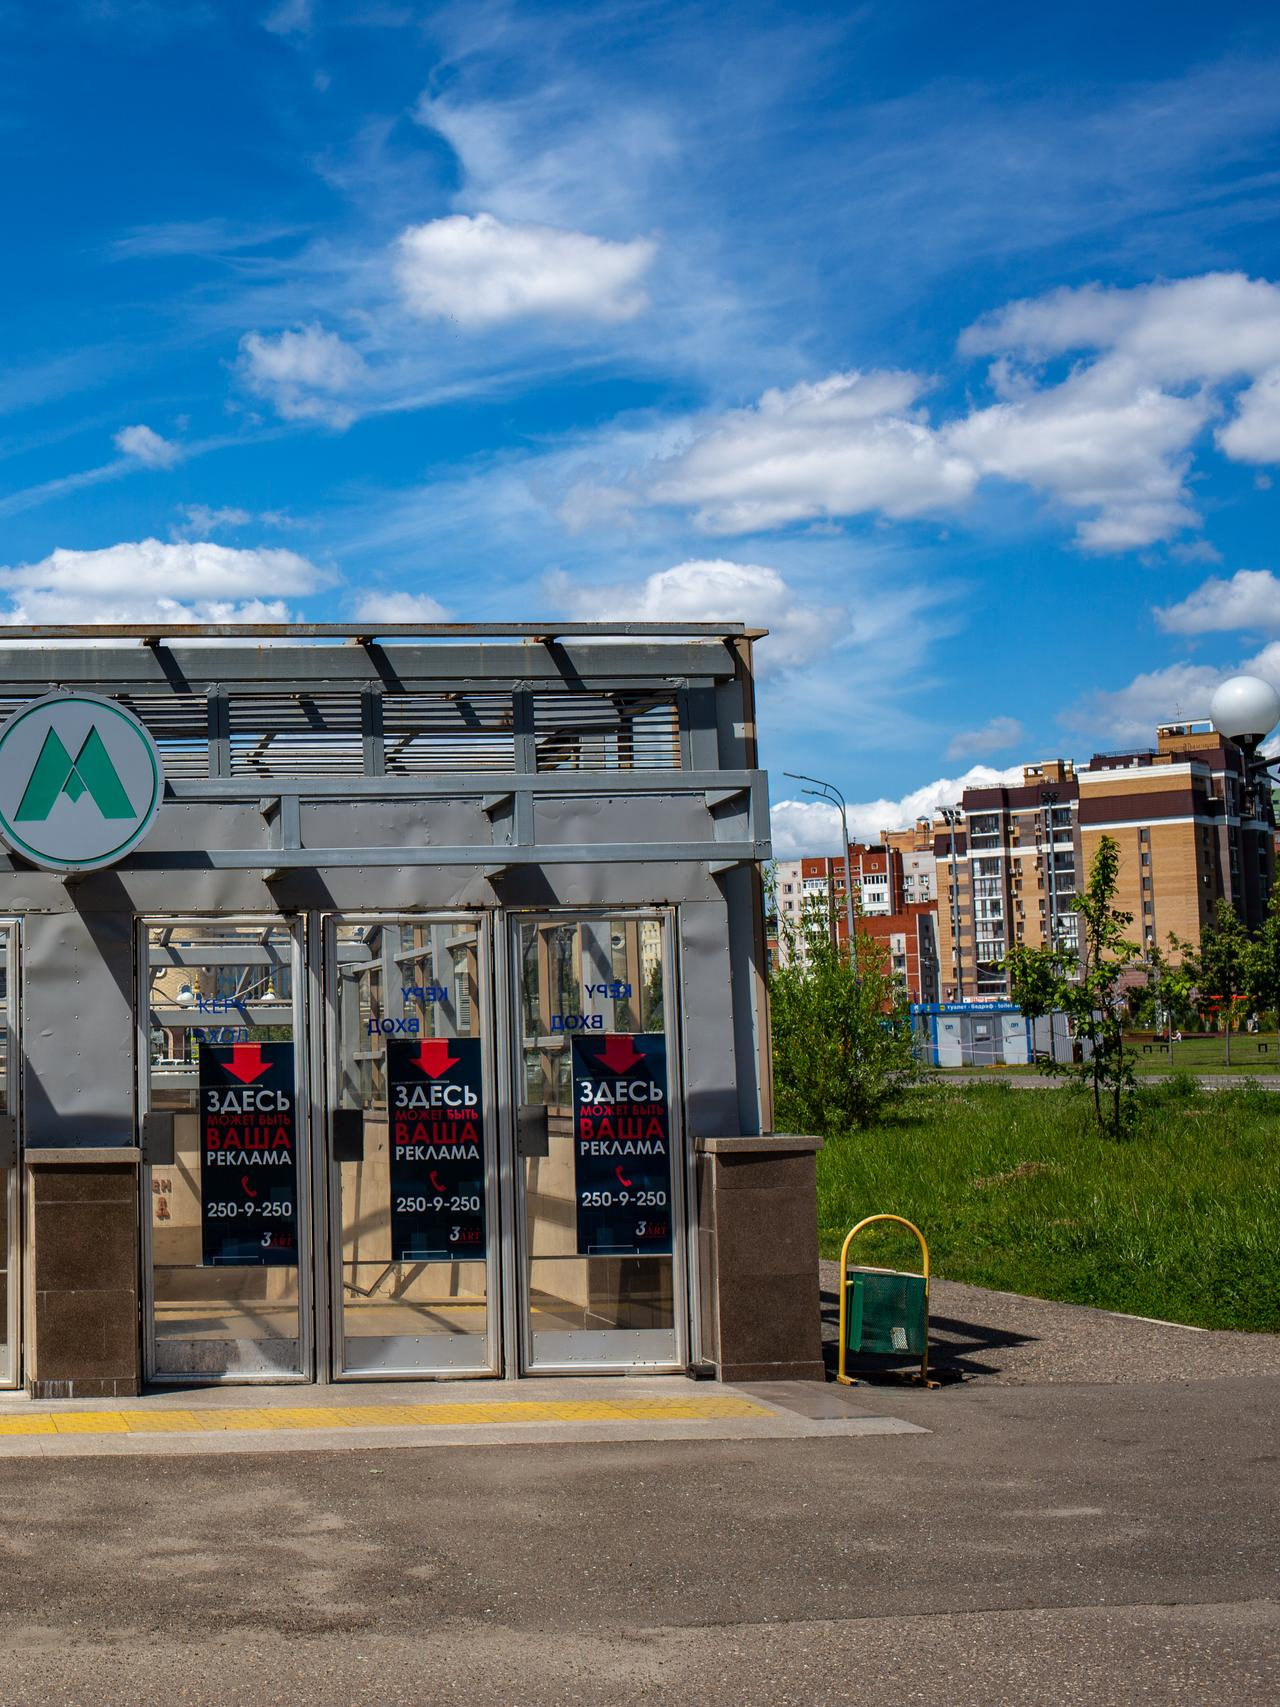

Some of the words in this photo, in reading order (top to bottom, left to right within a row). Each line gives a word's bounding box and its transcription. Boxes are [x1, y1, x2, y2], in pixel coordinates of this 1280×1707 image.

[395, 1085, 478, 1109] ЗДЕСЬ
[580, 1080, 663, 1105] ЗДЕСЬ
[207, 1090, 290, 1114] ЗДЕСЬ
[579, 1104, 628, 1116] МОЖЕТ
[632, 1104, 664, 1116] БЫТЬ
[207, 1115, 254, 1126] МОЖЕТ
[259, 1114, 291, 1126] БЫТЬ
[395, 1110, 443, 1121] МОЖЕТ
[447, 1109, 479, 1120] БЫТЬ
[395, 1122, 479, 1145] ВАША
[579, 1117, 664, 1140] ВАША
[207, 1127, 291, 1150] ВАША
[395, 1145, 480, 1161] РЕКЛАМА
[580, 1140, 666, 1156] РЕКЛАМА
[207, 1151, 292, 1166] РЕКЛАМА
[396, 1196, 480, 1212] 250-9-250
[581, 1191, 666, 1207] 250-9-250
[207, 1202, 292, 1217] 250-9-250
